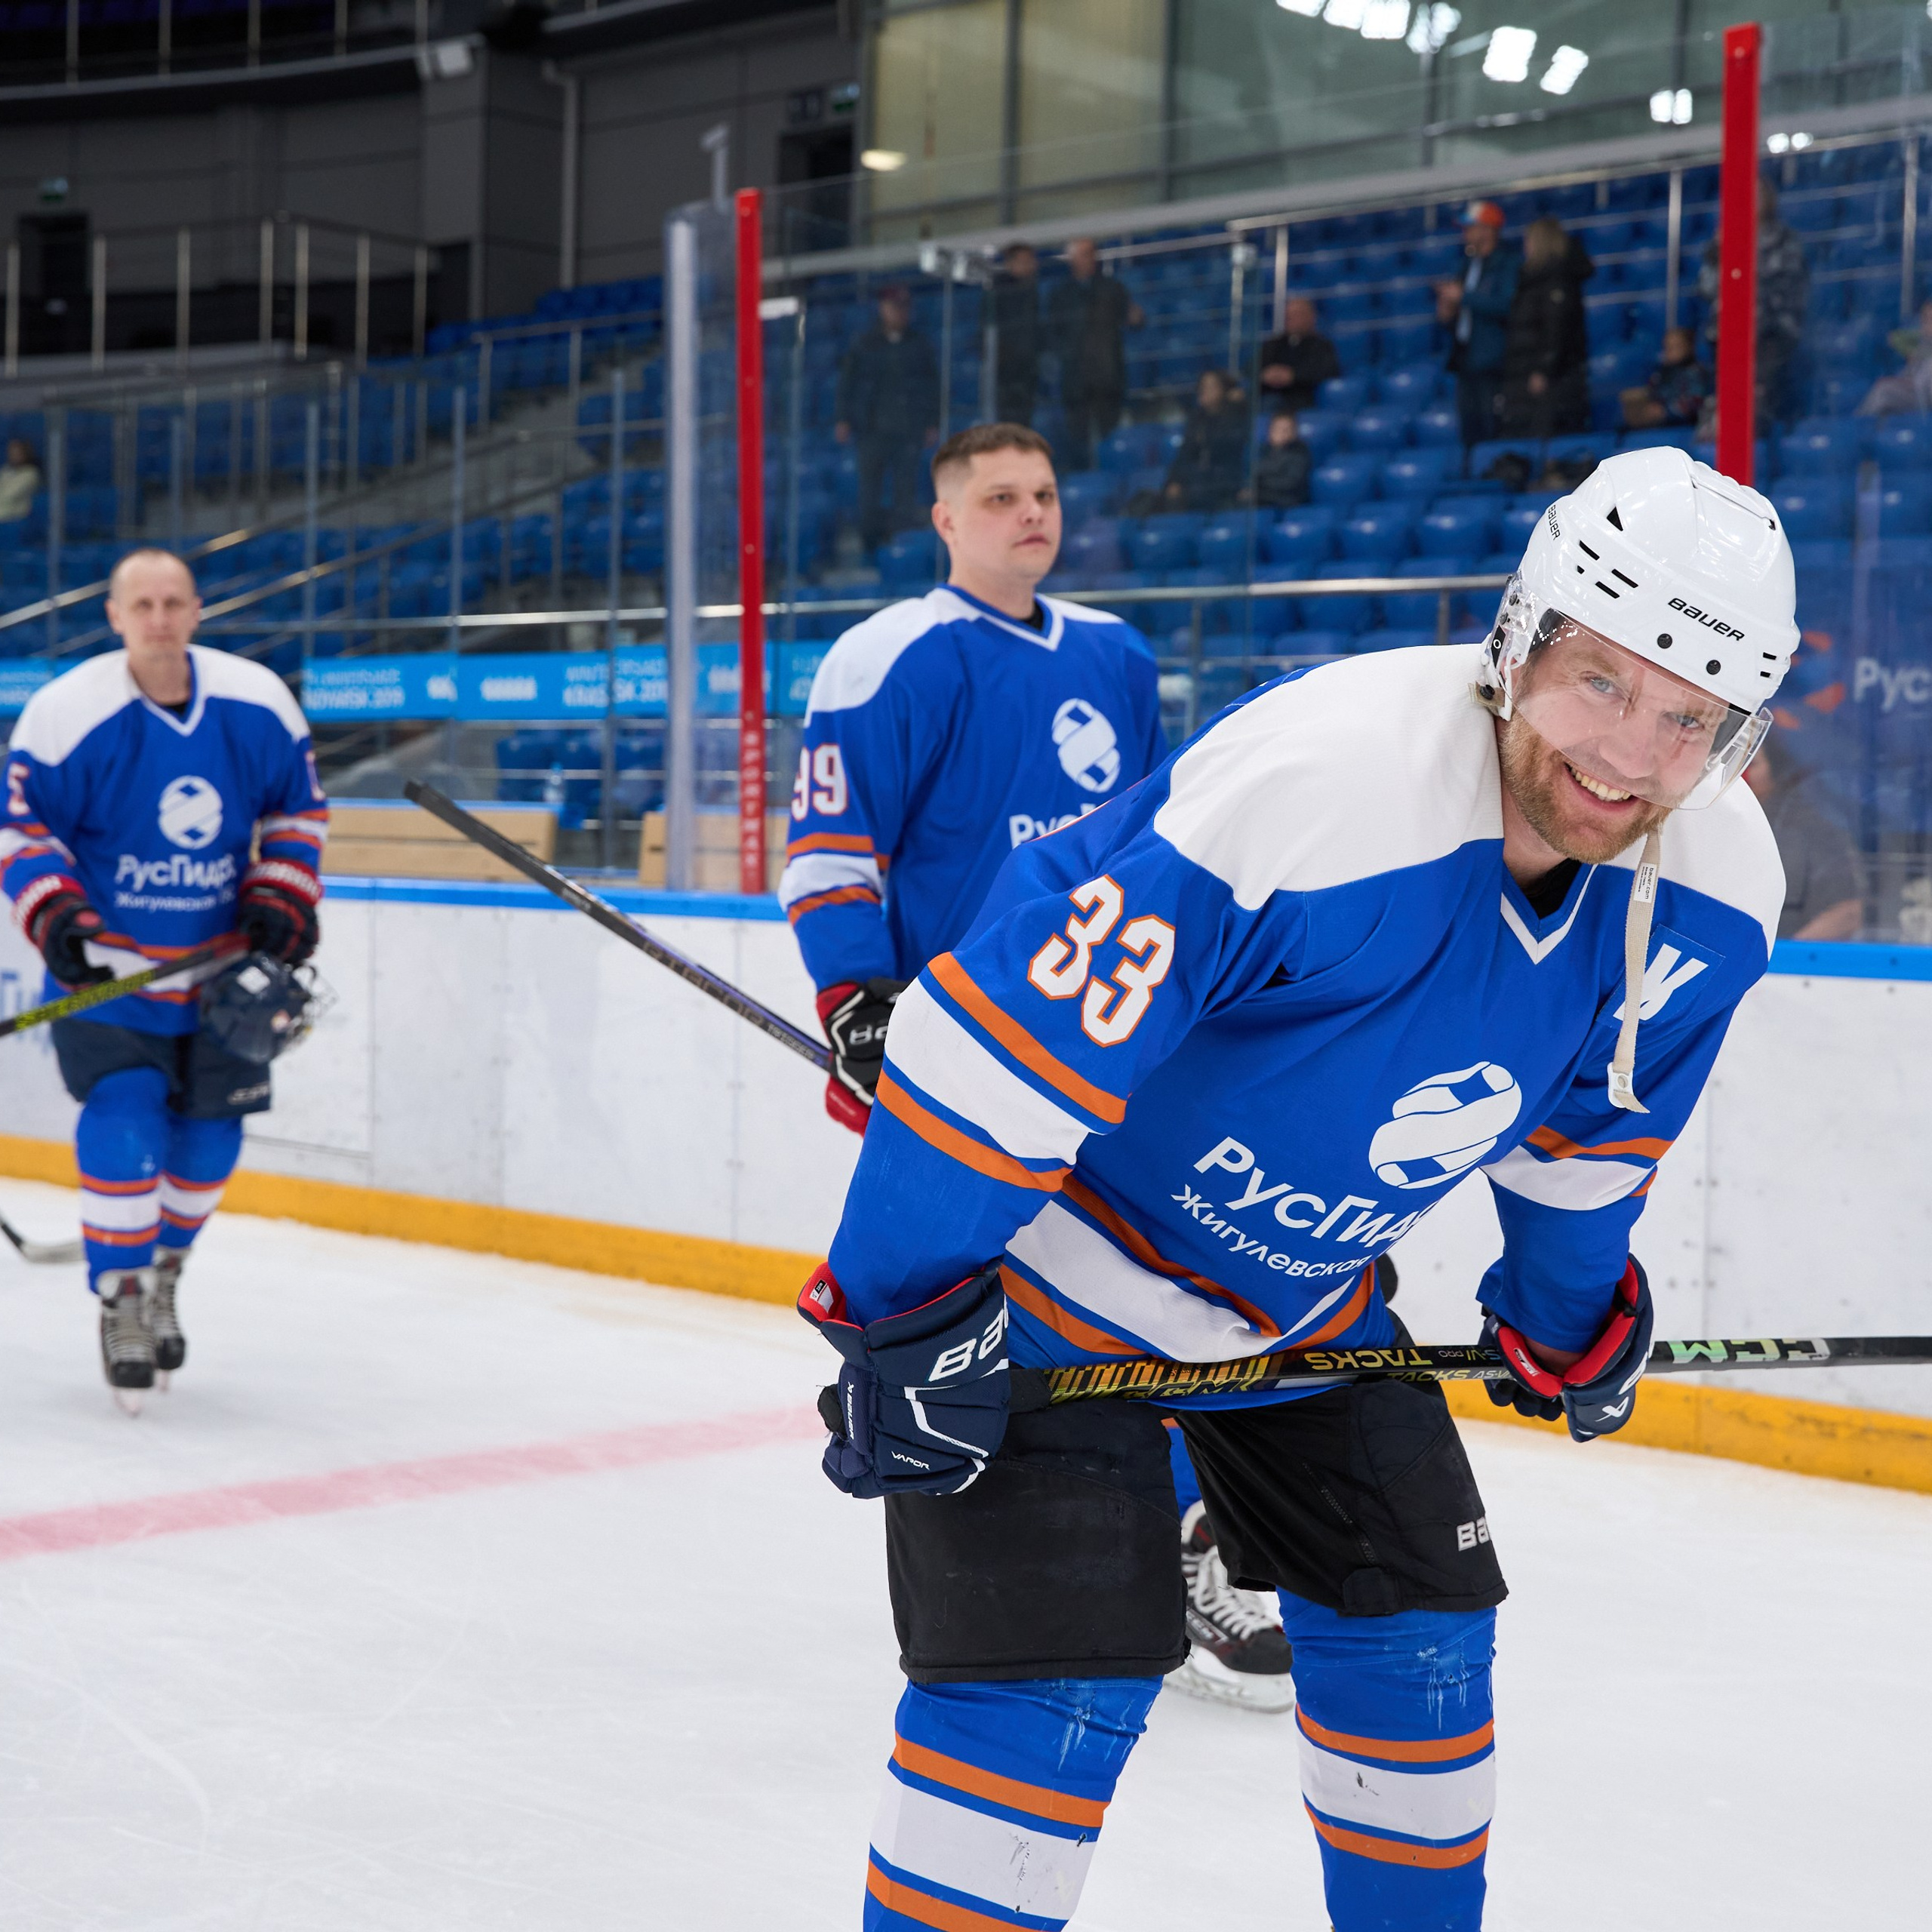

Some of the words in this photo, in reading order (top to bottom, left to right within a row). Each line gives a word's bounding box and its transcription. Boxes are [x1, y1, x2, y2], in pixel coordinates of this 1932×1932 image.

[1026, 873, 1176, 1048] 33
[1304, 1349, 1433, 1371] TACKS
[1438, 1349, 1465, 1358] PRO
[1666, 1338, 1832, 1364] CCM
[890, 1451, 931, 1471] VAPOR
